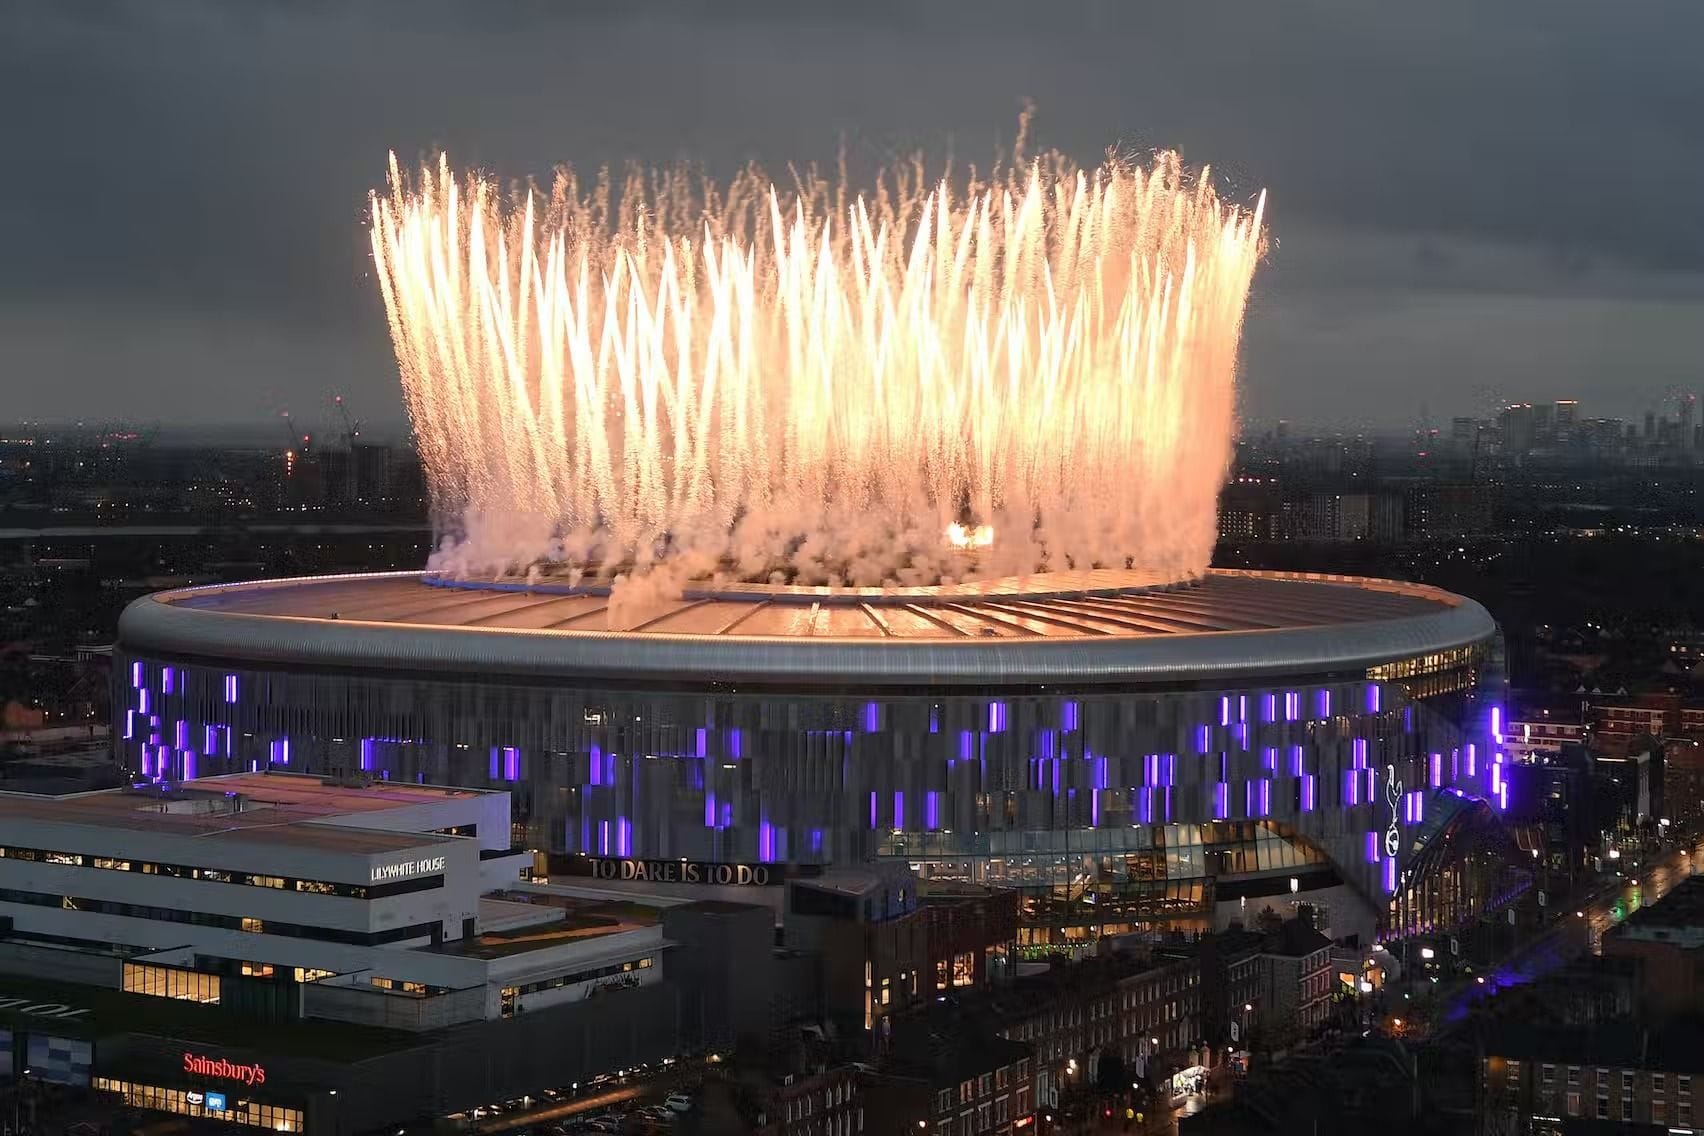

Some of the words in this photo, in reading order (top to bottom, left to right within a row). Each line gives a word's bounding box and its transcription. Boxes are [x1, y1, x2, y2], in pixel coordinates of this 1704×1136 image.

[371, 861, 415, 880] LILYWHITE
[416, 856, 446, 873] HOUSE
[588, 858, 616, 879] TO
[620, 860, 676, 882] DARE
[681, 861, 700, 882] IS
[704, 864, 732, 885] TO
[737, 864, 769, 885] DO
[183, 1052, 266, 1086] Sainsbury's
